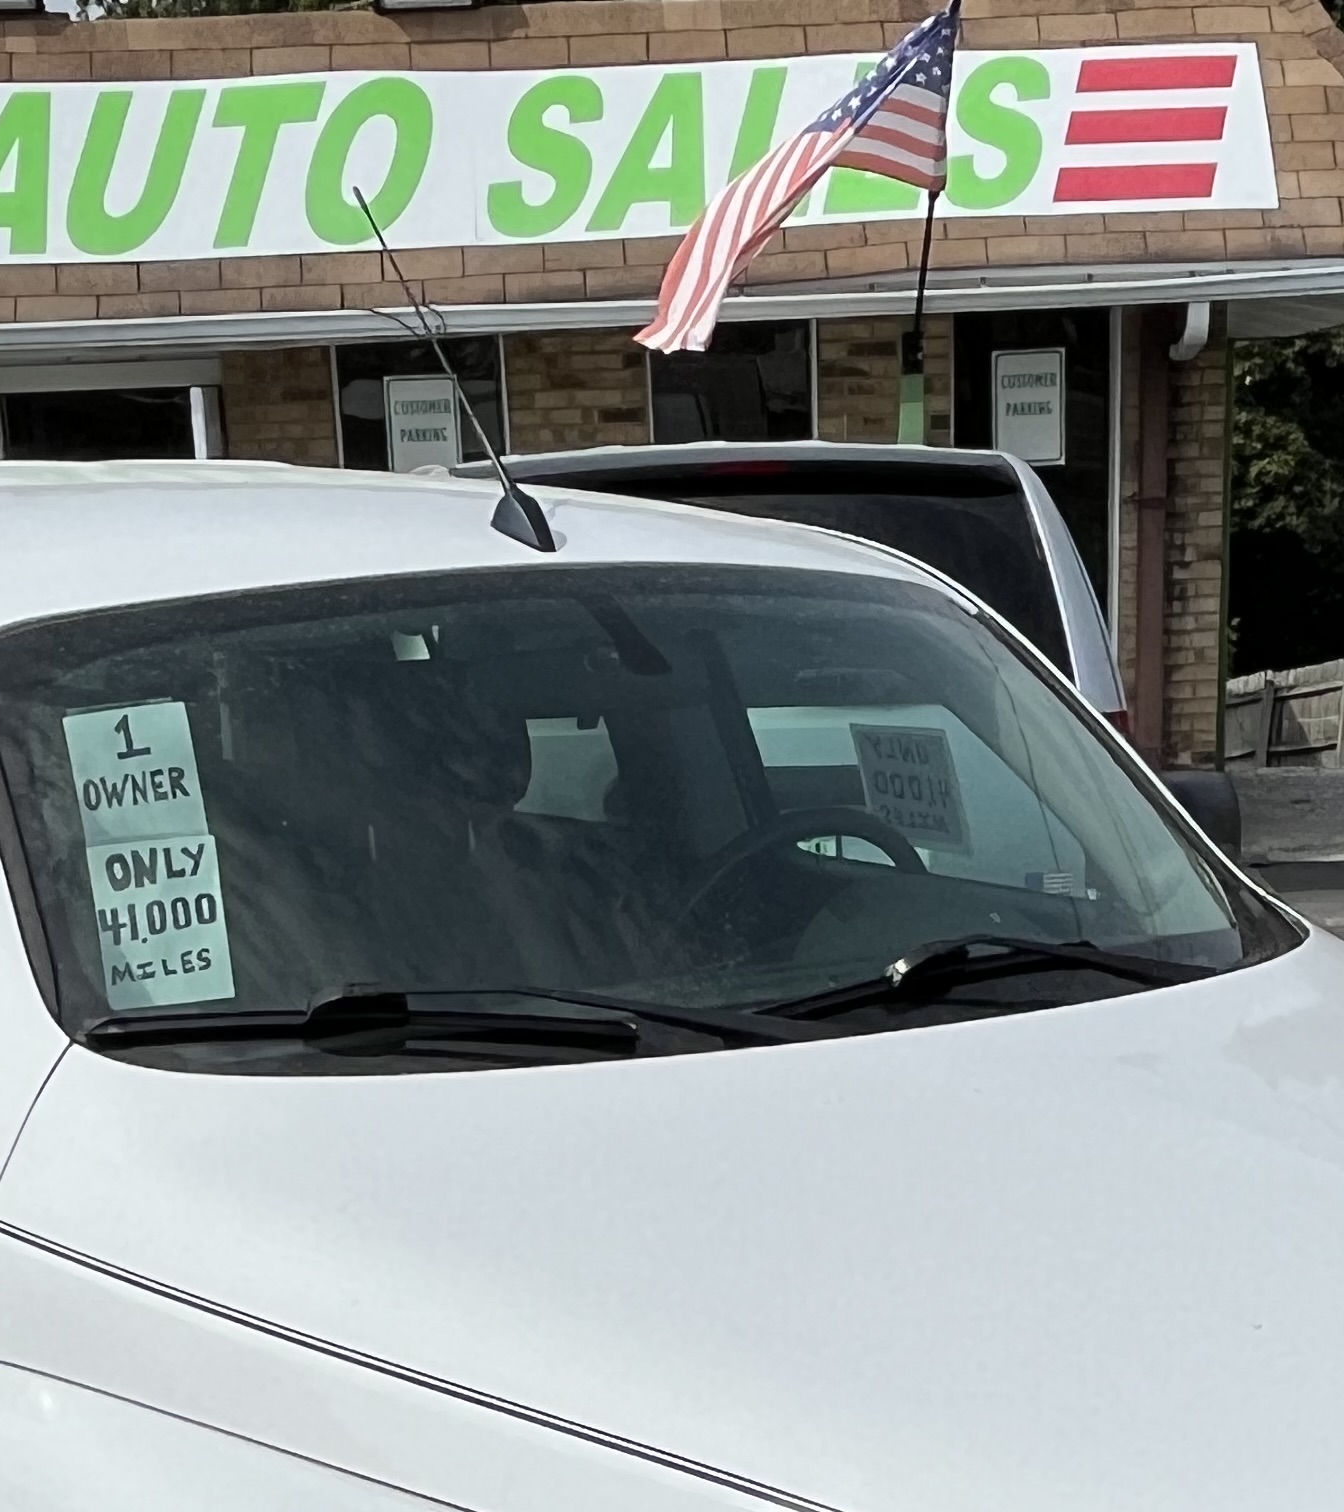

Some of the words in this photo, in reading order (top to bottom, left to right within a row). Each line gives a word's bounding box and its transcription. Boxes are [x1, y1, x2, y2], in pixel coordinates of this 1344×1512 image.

[113, 713, 152, 760] 1
[82, 766, 191, 812] OWNER
[104, 843, 206, 892] ONLY
[110, 947, 213, 986] MILES
